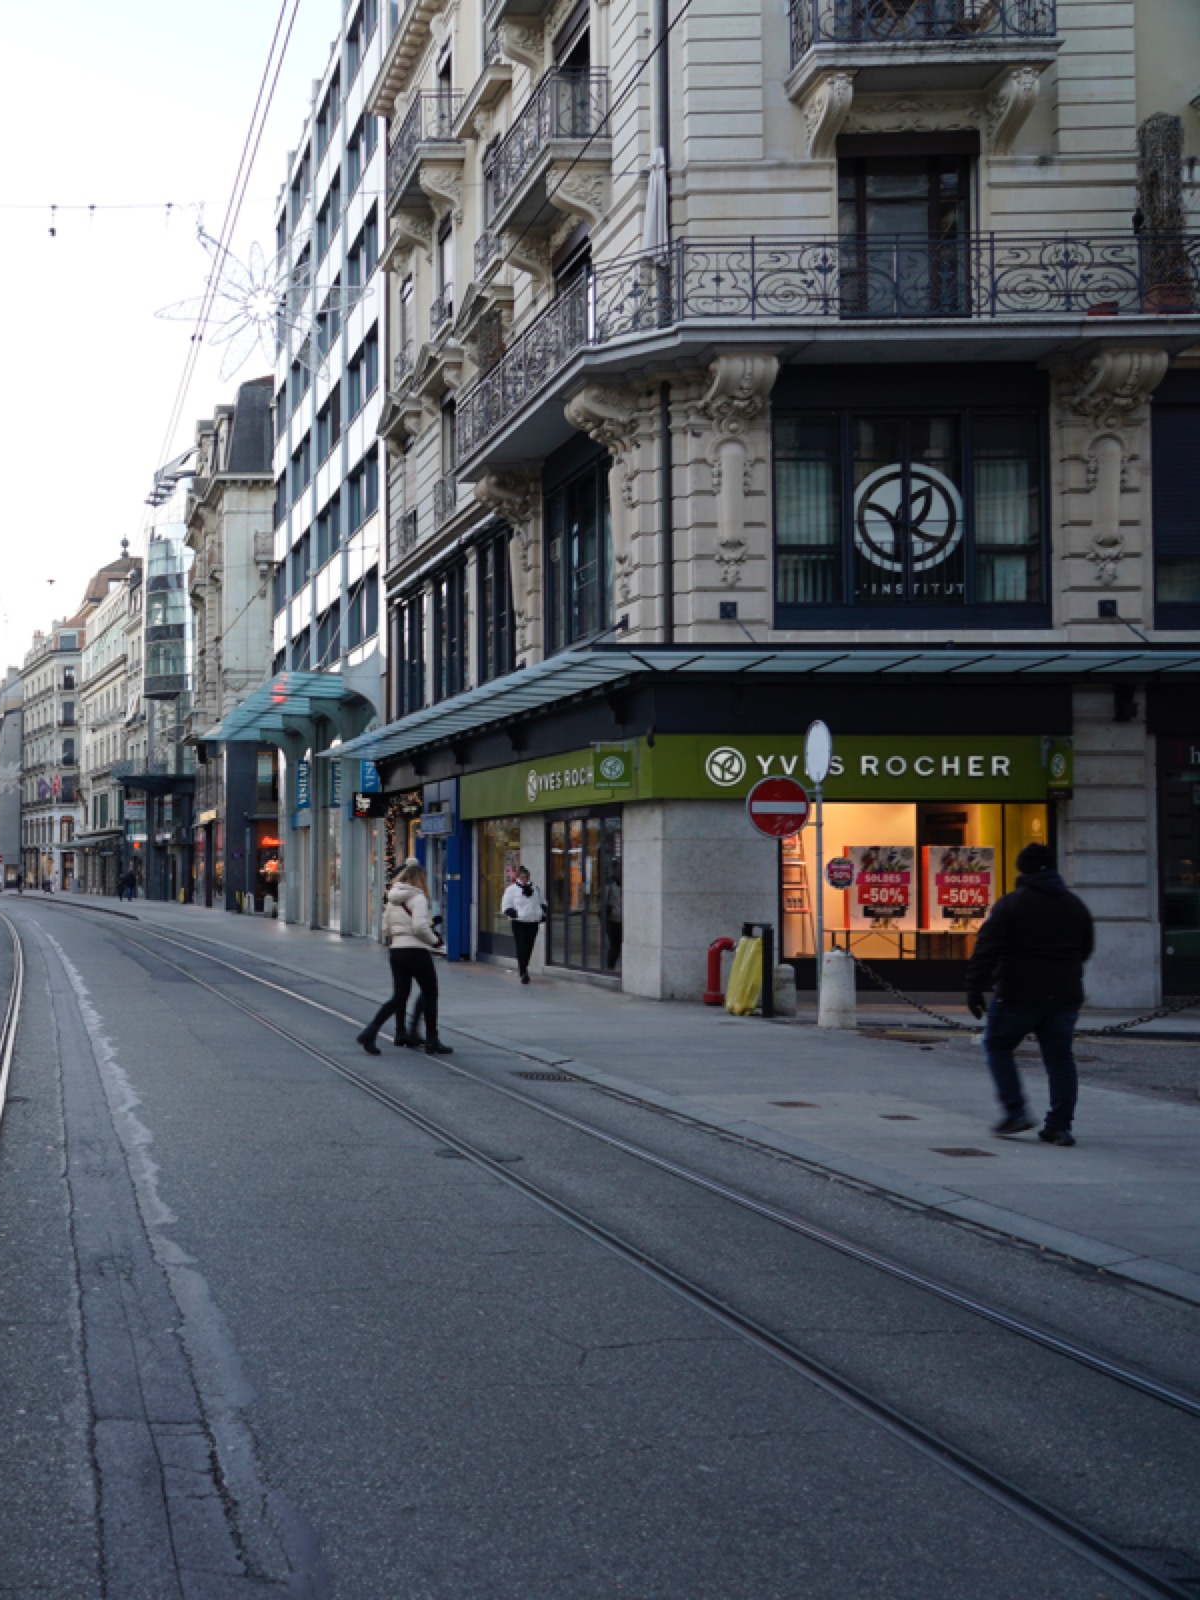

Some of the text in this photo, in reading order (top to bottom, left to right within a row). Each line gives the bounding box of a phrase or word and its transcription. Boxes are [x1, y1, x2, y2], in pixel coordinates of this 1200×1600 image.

[756, 755, 1011, 777] YVS ROCHER
[563, 767, 593, 787] ROCH
[864, 873, 901, 883] SOLDES
[943, 874, 981, 883] SOLDES
[863, 887, 904, 903] -50%
[941, 887, 983, 903] -50%
